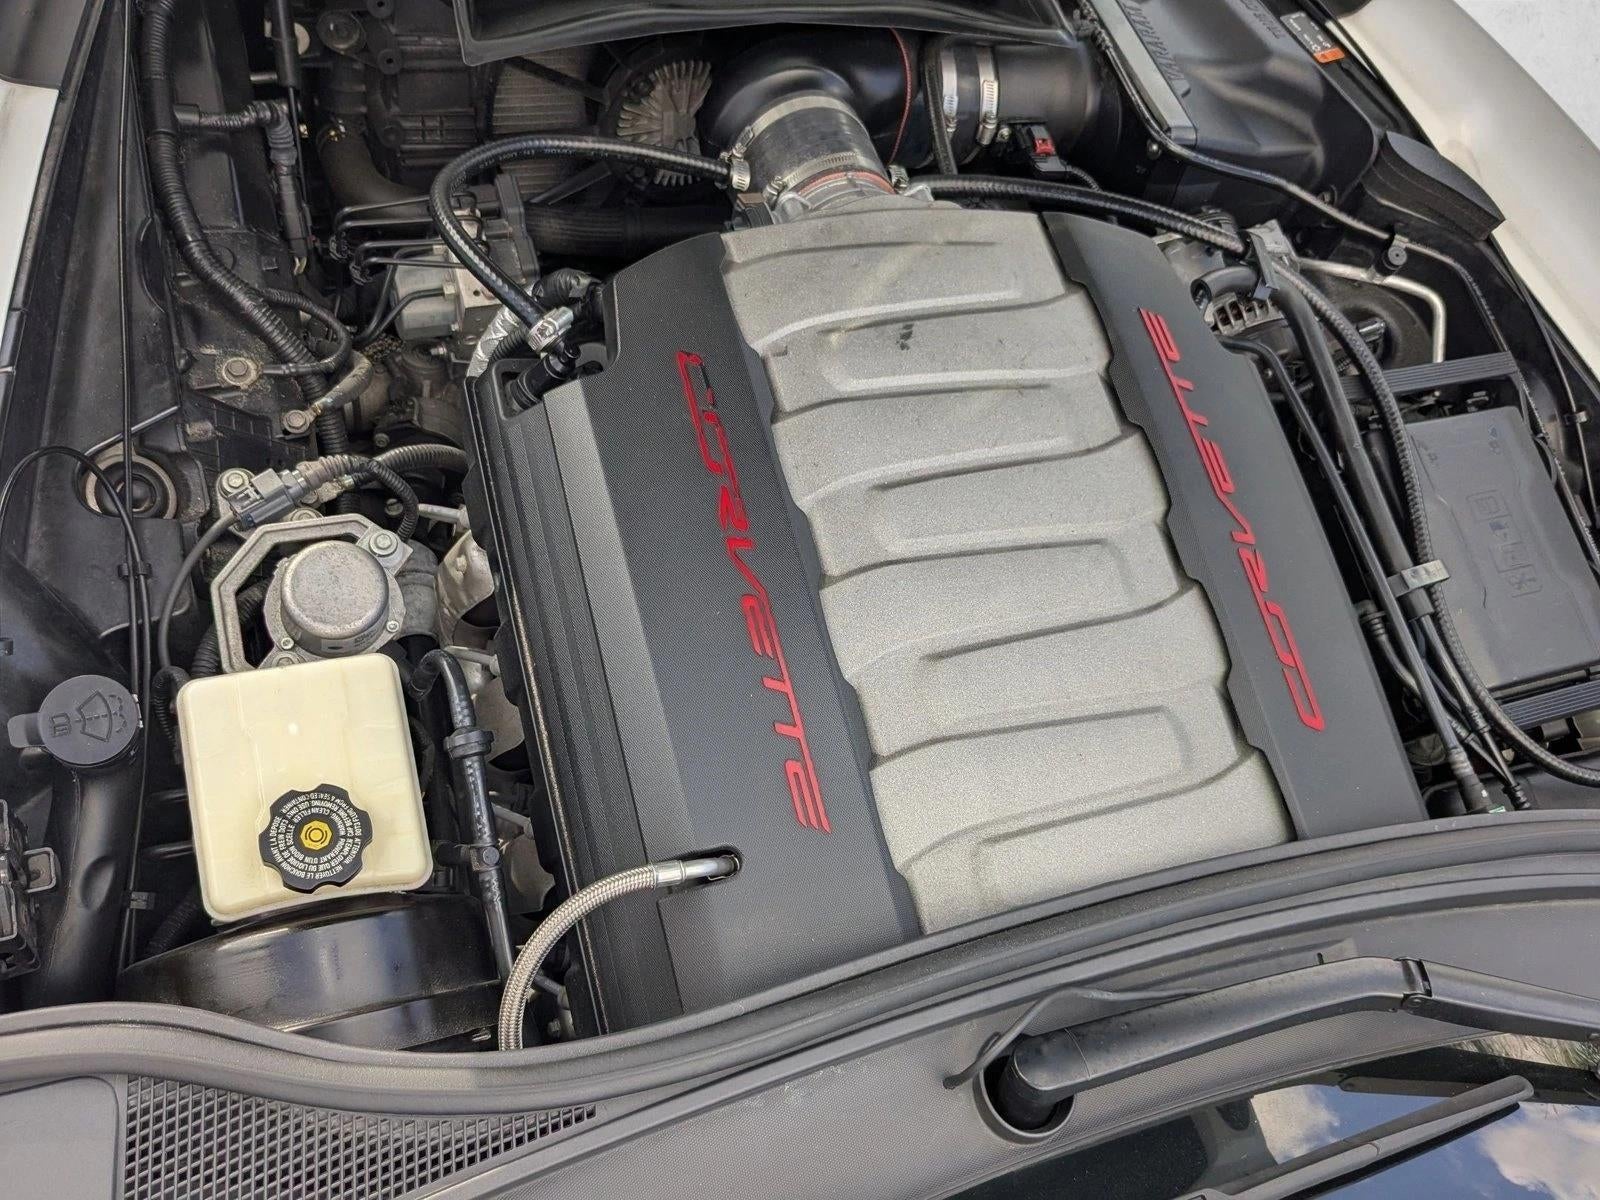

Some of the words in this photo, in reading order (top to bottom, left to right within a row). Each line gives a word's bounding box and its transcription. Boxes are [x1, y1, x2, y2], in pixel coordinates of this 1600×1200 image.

[1138, 306, 1326, 732] CORVETTE
[676, 350, 833, 834] CORVETTE
[292, 807, 311, 823] FILLER
[311, 807, 330, 815] CLEAN
[337, 805, 352, 827] BEFORE
[346, 827, 355, 837] CAP
[269, 837, 278, 846] LA
[275, 834, 286, 850] FREIN
[271, 846, 284, 863] AVANT
[281, 850, 291, 859] DE
[289, 845, 305, 861] BIDON
[320, 838, 345, 863] PROVENANT
[280, 861, 306, 878] BOUCHON
[315, 865, 343, 879] NETTOYER
[318, 863, 331, 871] QUE
